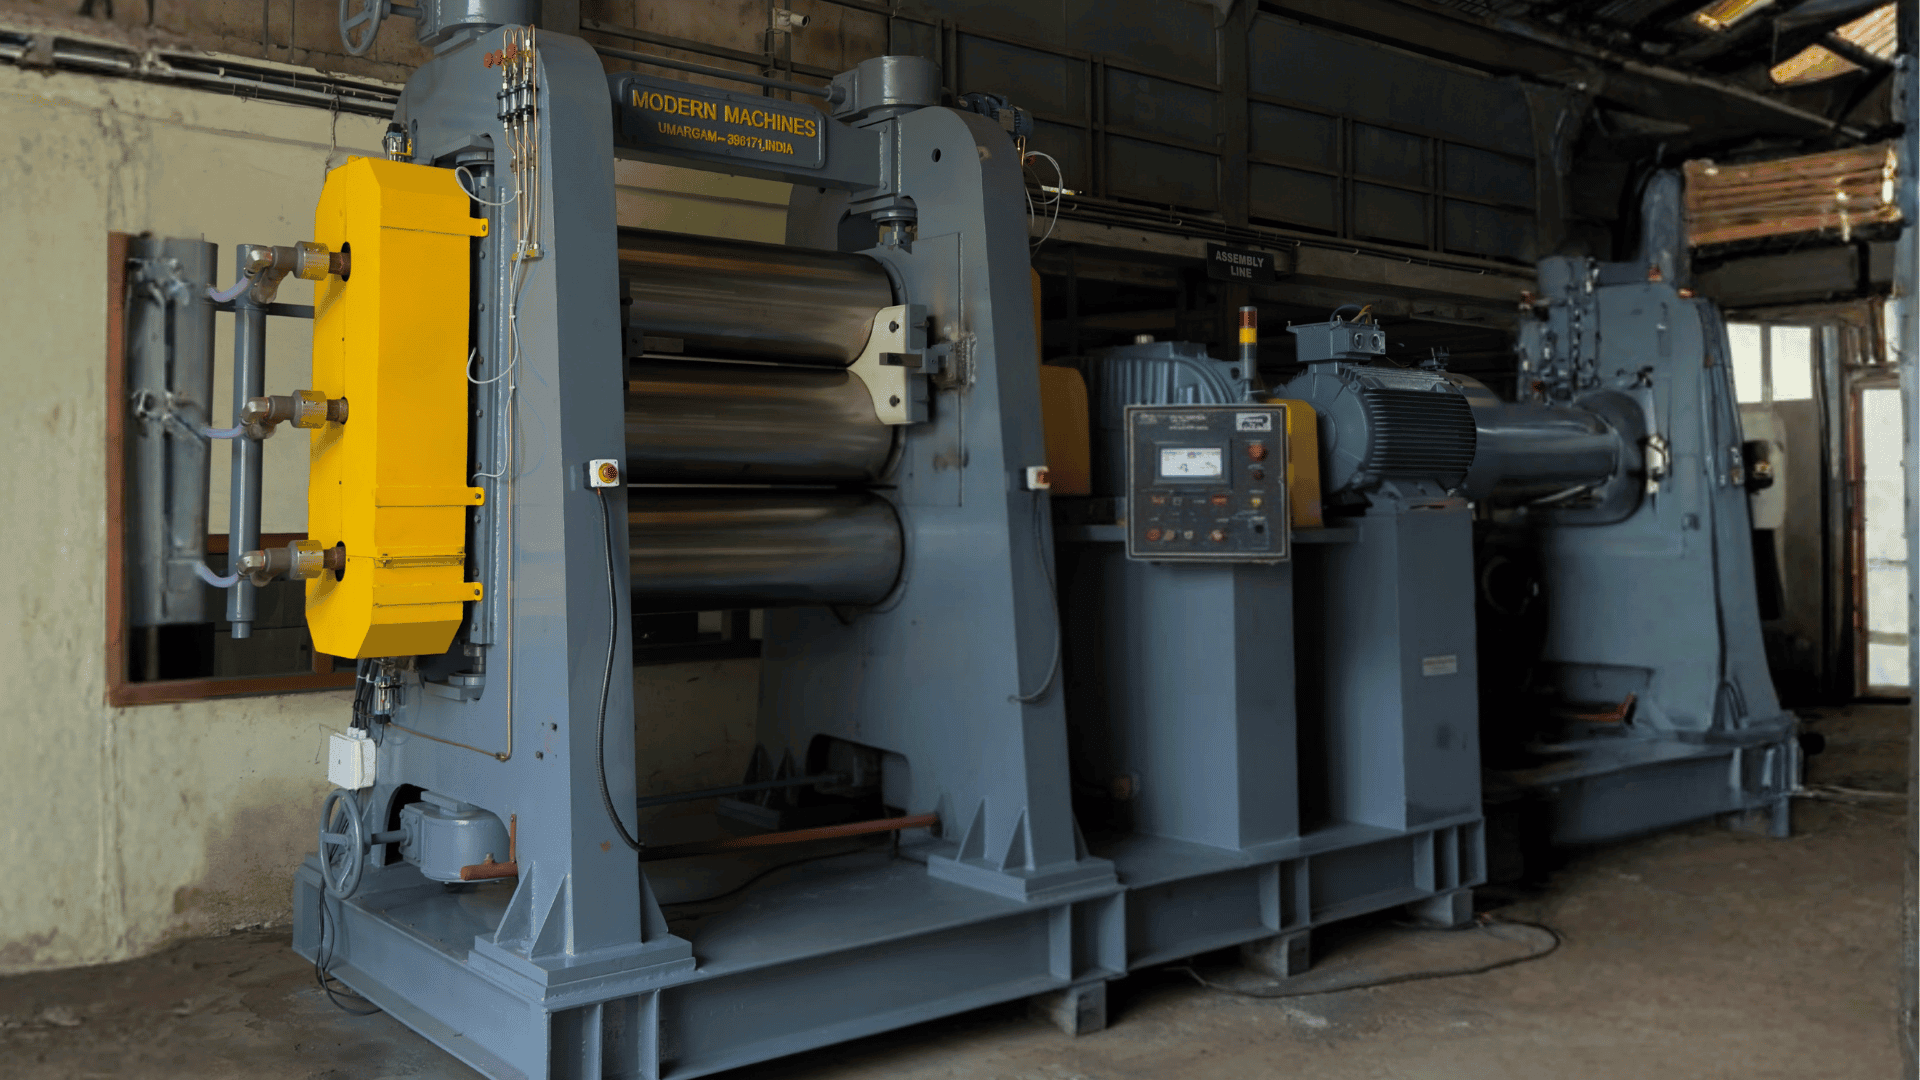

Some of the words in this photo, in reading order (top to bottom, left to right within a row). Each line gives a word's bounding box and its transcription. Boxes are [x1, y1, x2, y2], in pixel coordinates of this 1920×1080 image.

[632, 89, 717, 121] MODERN
[724, 105, 816, 138] MACHINES
[1215, 250, 1264, 268] ASSEMBLY
[1230, 265, 1252, 278] LINE
